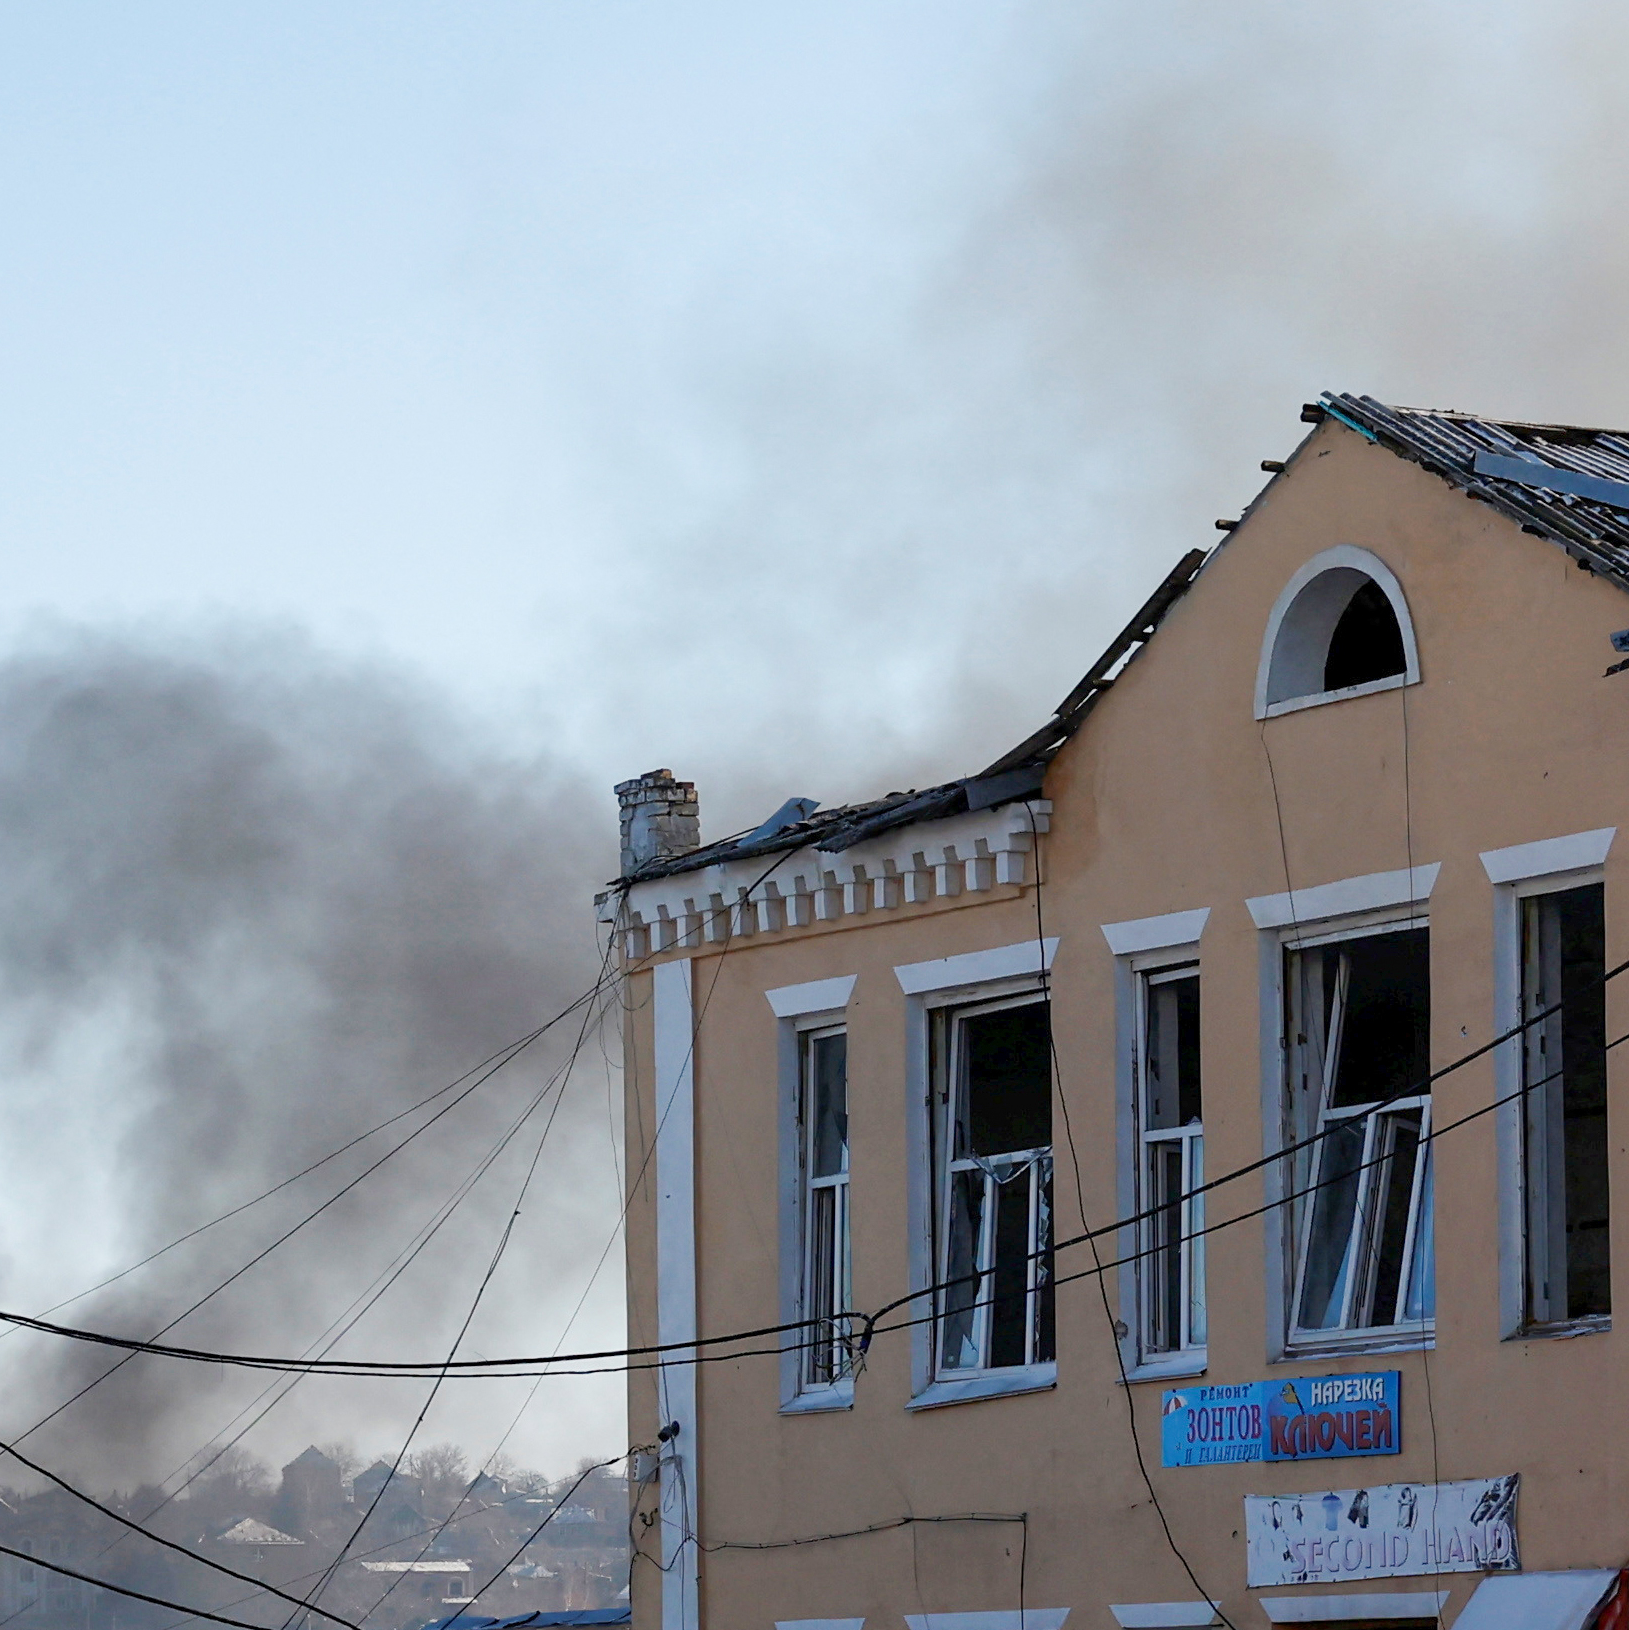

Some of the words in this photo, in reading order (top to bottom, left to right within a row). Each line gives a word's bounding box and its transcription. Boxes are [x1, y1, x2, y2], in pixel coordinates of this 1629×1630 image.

[1200, 1387, 1250, 1401] РЕМОНТ
[1311, 1377, 1385, 1407] НАРЕЗКА
[1187, 1404, 1263, 1443] ЗОНТОВ
[1270, 1403, 1392, 1458] КЛЮЧЕЙ
[1290, 1530, 1410, 1575] SECOND
[1422, 1518, 1513, 1566] HAND
